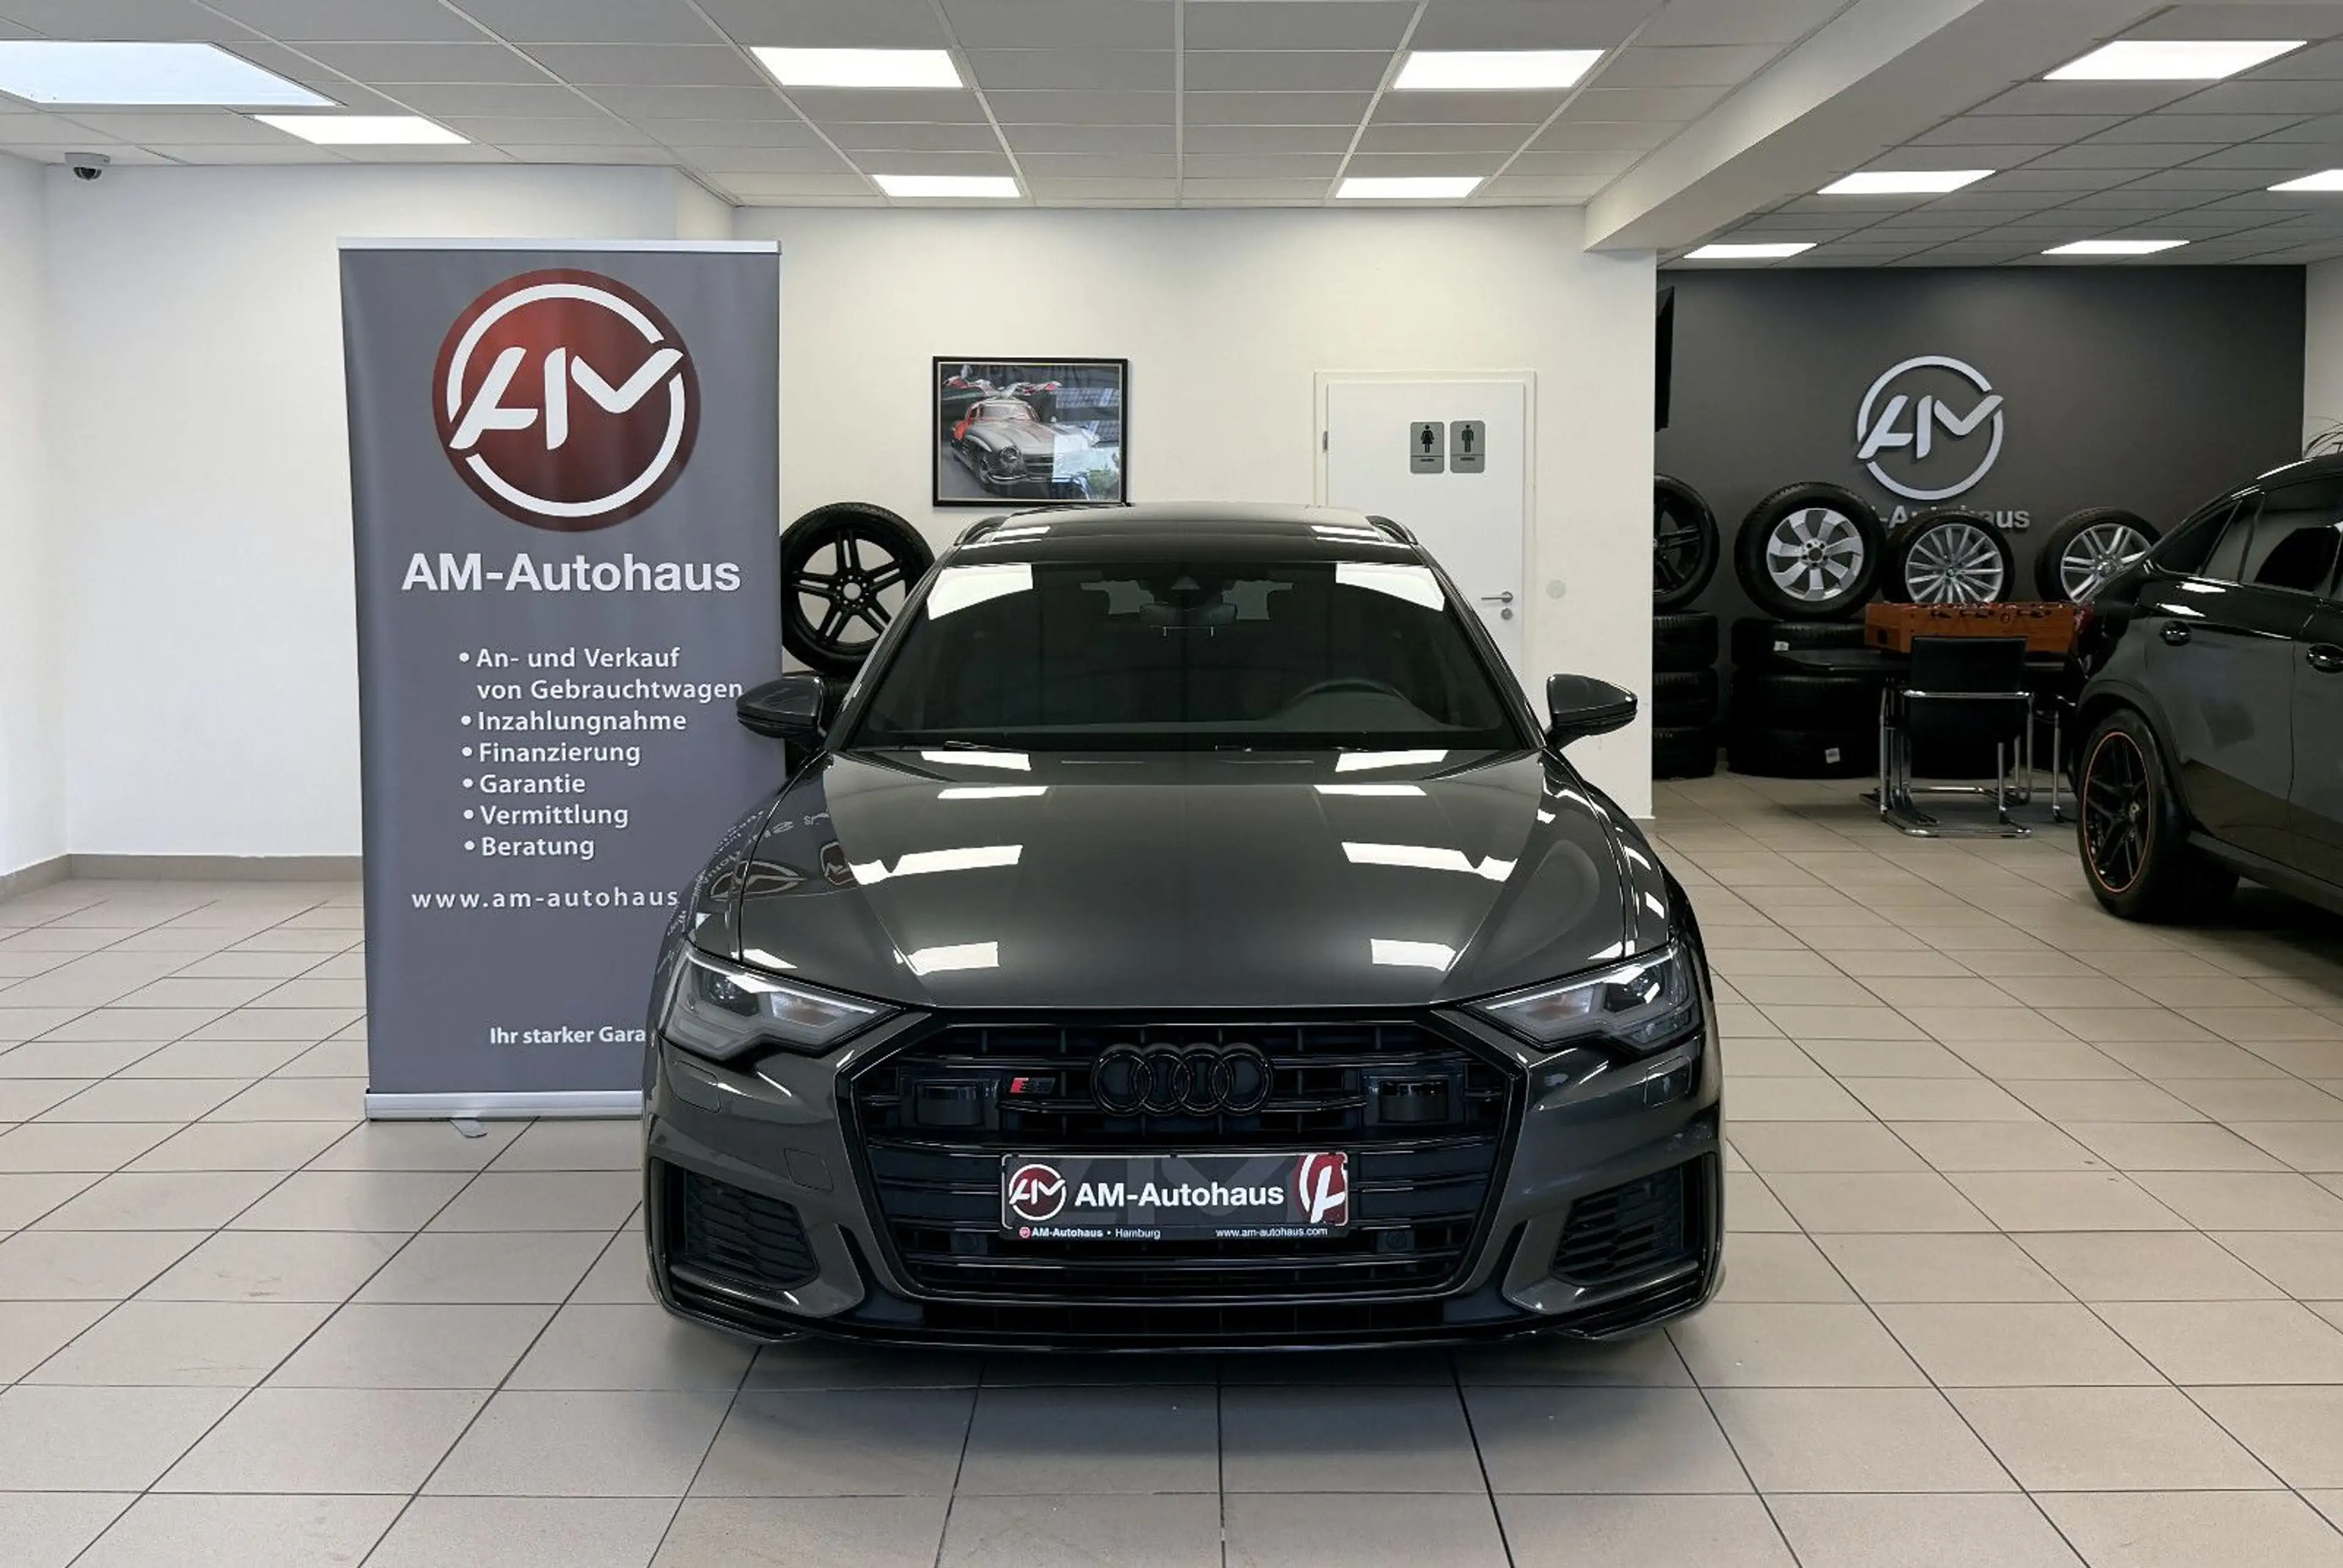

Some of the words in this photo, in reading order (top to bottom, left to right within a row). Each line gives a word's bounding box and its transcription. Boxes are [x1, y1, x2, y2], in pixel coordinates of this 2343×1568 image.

[401, 553, 741, 592] AM-Autohaus
[476, 648, 520, 667] An-
[528, 647, 575, 668] und
[584, 647, 681, 668] Verkauf
[477, 685, 522, 699] von
[531, 678, 743, 704] Gebrauchtwagen
[478, 710, 687, 736] Inzahlungnahme
[479, 741, 641, 767] Finanzierung
[480, 773, 586, 793] Garantie
[480, 804, 629, 829] Vermittlung
[481, 836, 595, 860] Beratung
[411, 886, 678, 908] www.am-autohaus
[491, 1027, 519, 1045] Ihr
[523, 1026, 594, 1044] starker
[599, 1026, 646, 1042] Gara
[1074, 1182, 1284, 1207] AM-Autohaus
[1031, 1227, 1104, 1238] AM-Autohaus
[1115, 1228, 1161, 1240] Hamburg
[1215, 1226, 1328, 1238] www.am-autohaus.com
